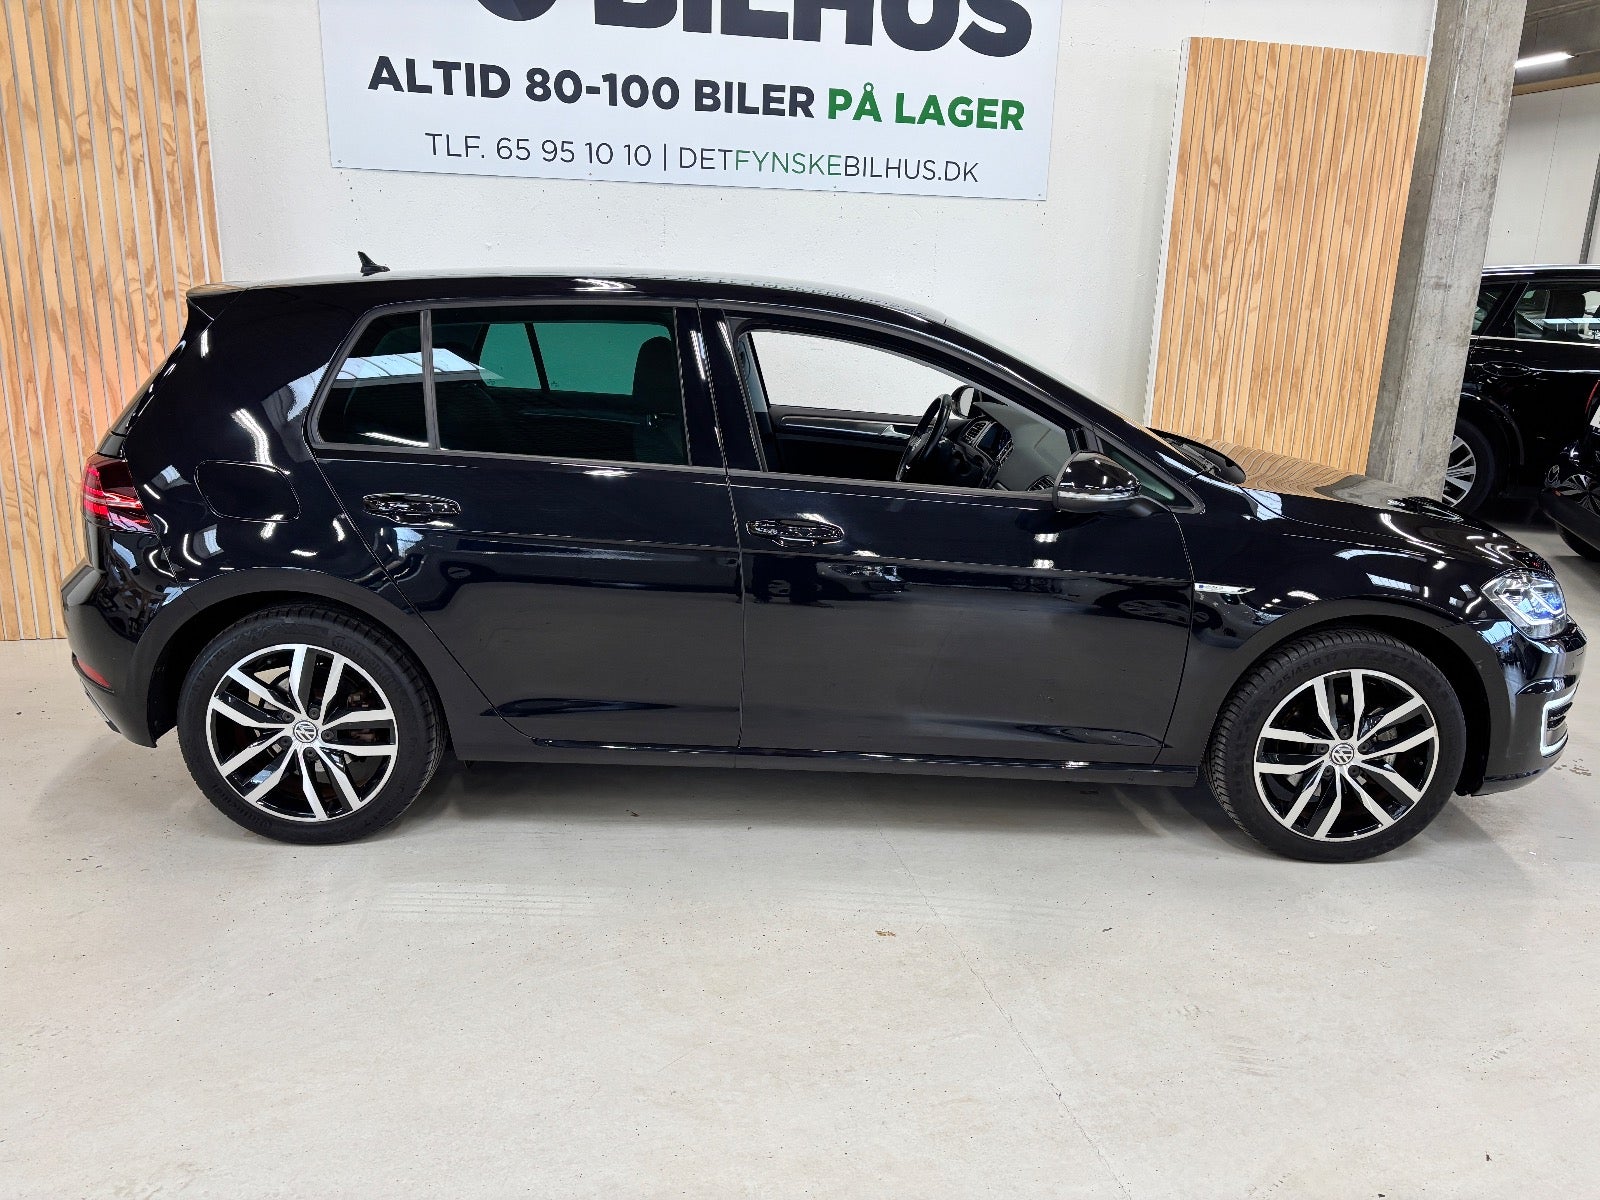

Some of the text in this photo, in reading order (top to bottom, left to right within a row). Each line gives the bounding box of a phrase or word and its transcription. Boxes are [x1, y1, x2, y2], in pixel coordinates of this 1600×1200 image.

[367, 56, 1025, 131] ALTID 80-100 BILER PÅ LAGER
[424, 132, 484, 159] TLF.
[496, 138, 531, 161] 65
[541, 140, 575, 164] 95
[585, 142, 614, 165] 10
[623, 144, 652, 167] 10
[679, 147, 979, 183] DETFYNSKEBILHUS.DK
